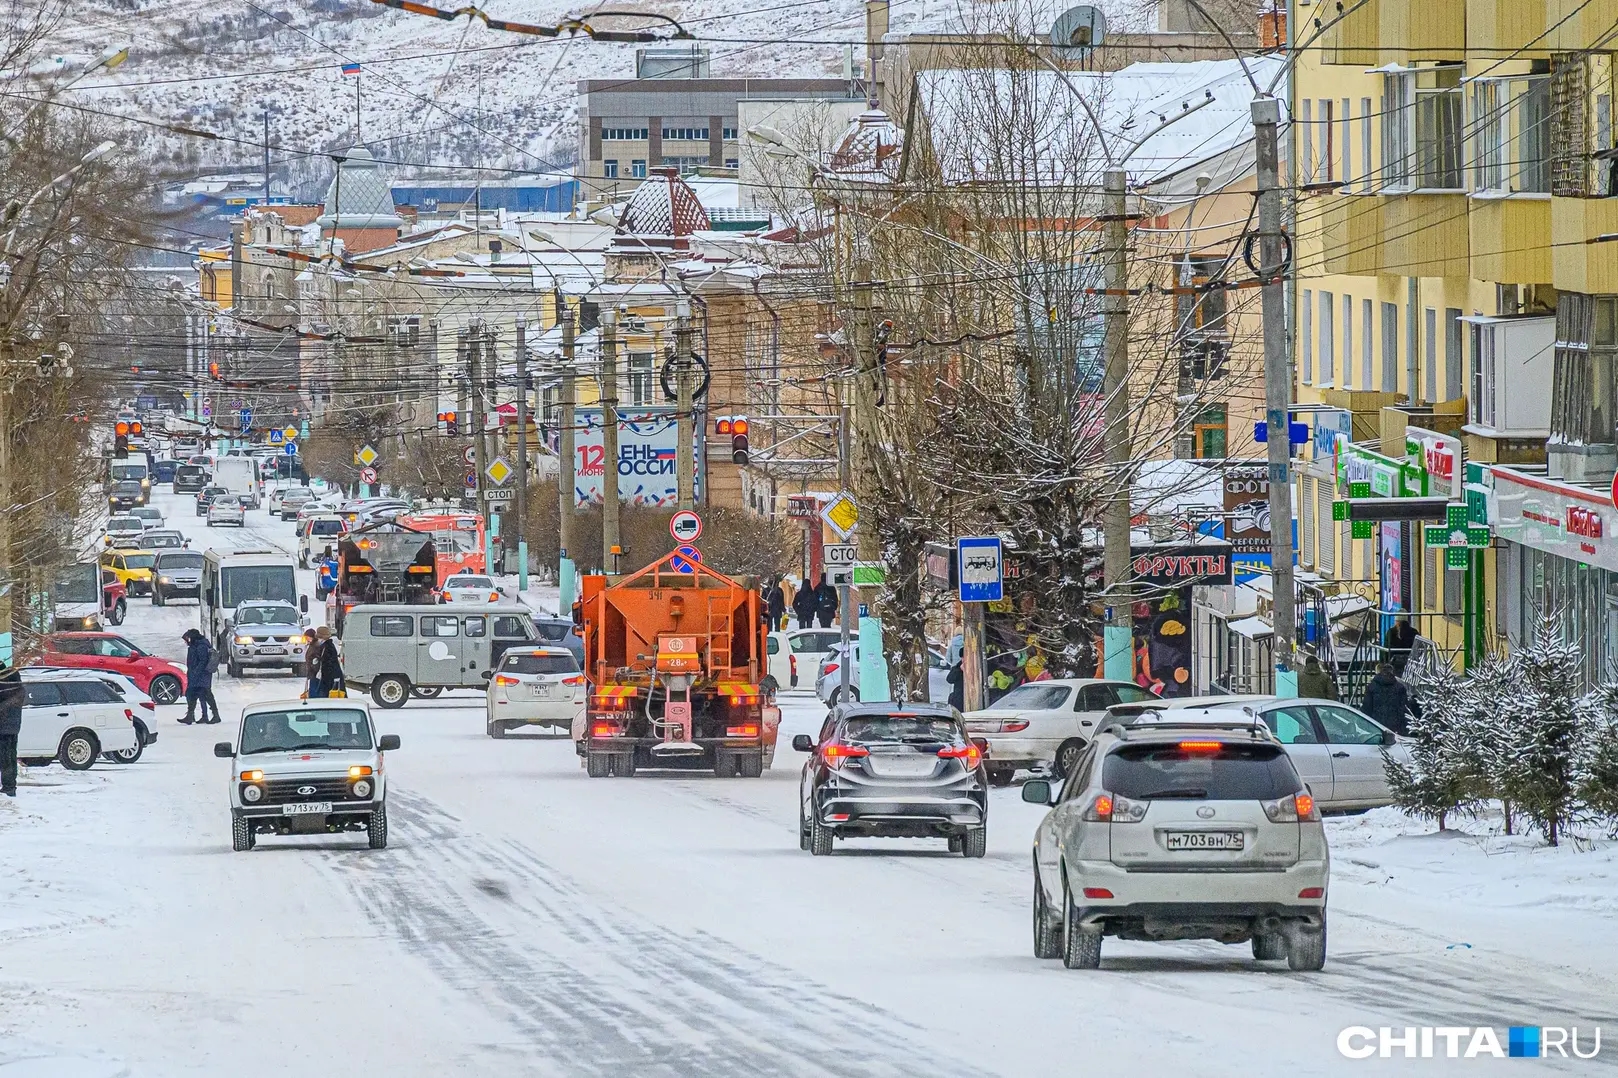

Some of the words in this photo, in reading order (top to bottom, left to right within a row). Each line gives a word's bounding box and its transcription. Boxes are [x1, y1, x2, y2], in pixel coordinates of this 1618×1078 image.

[577, 445, 605, 469] 12
[618, 445, 657, 459] ЕНЬ
[618, 460, 676, 475] ОССИ
[1226, 481, 1270, 493] ФОТ
[830, 548, 857, 560] СТО
[1133, 555, 1226, 576] ФРУКТЫ
